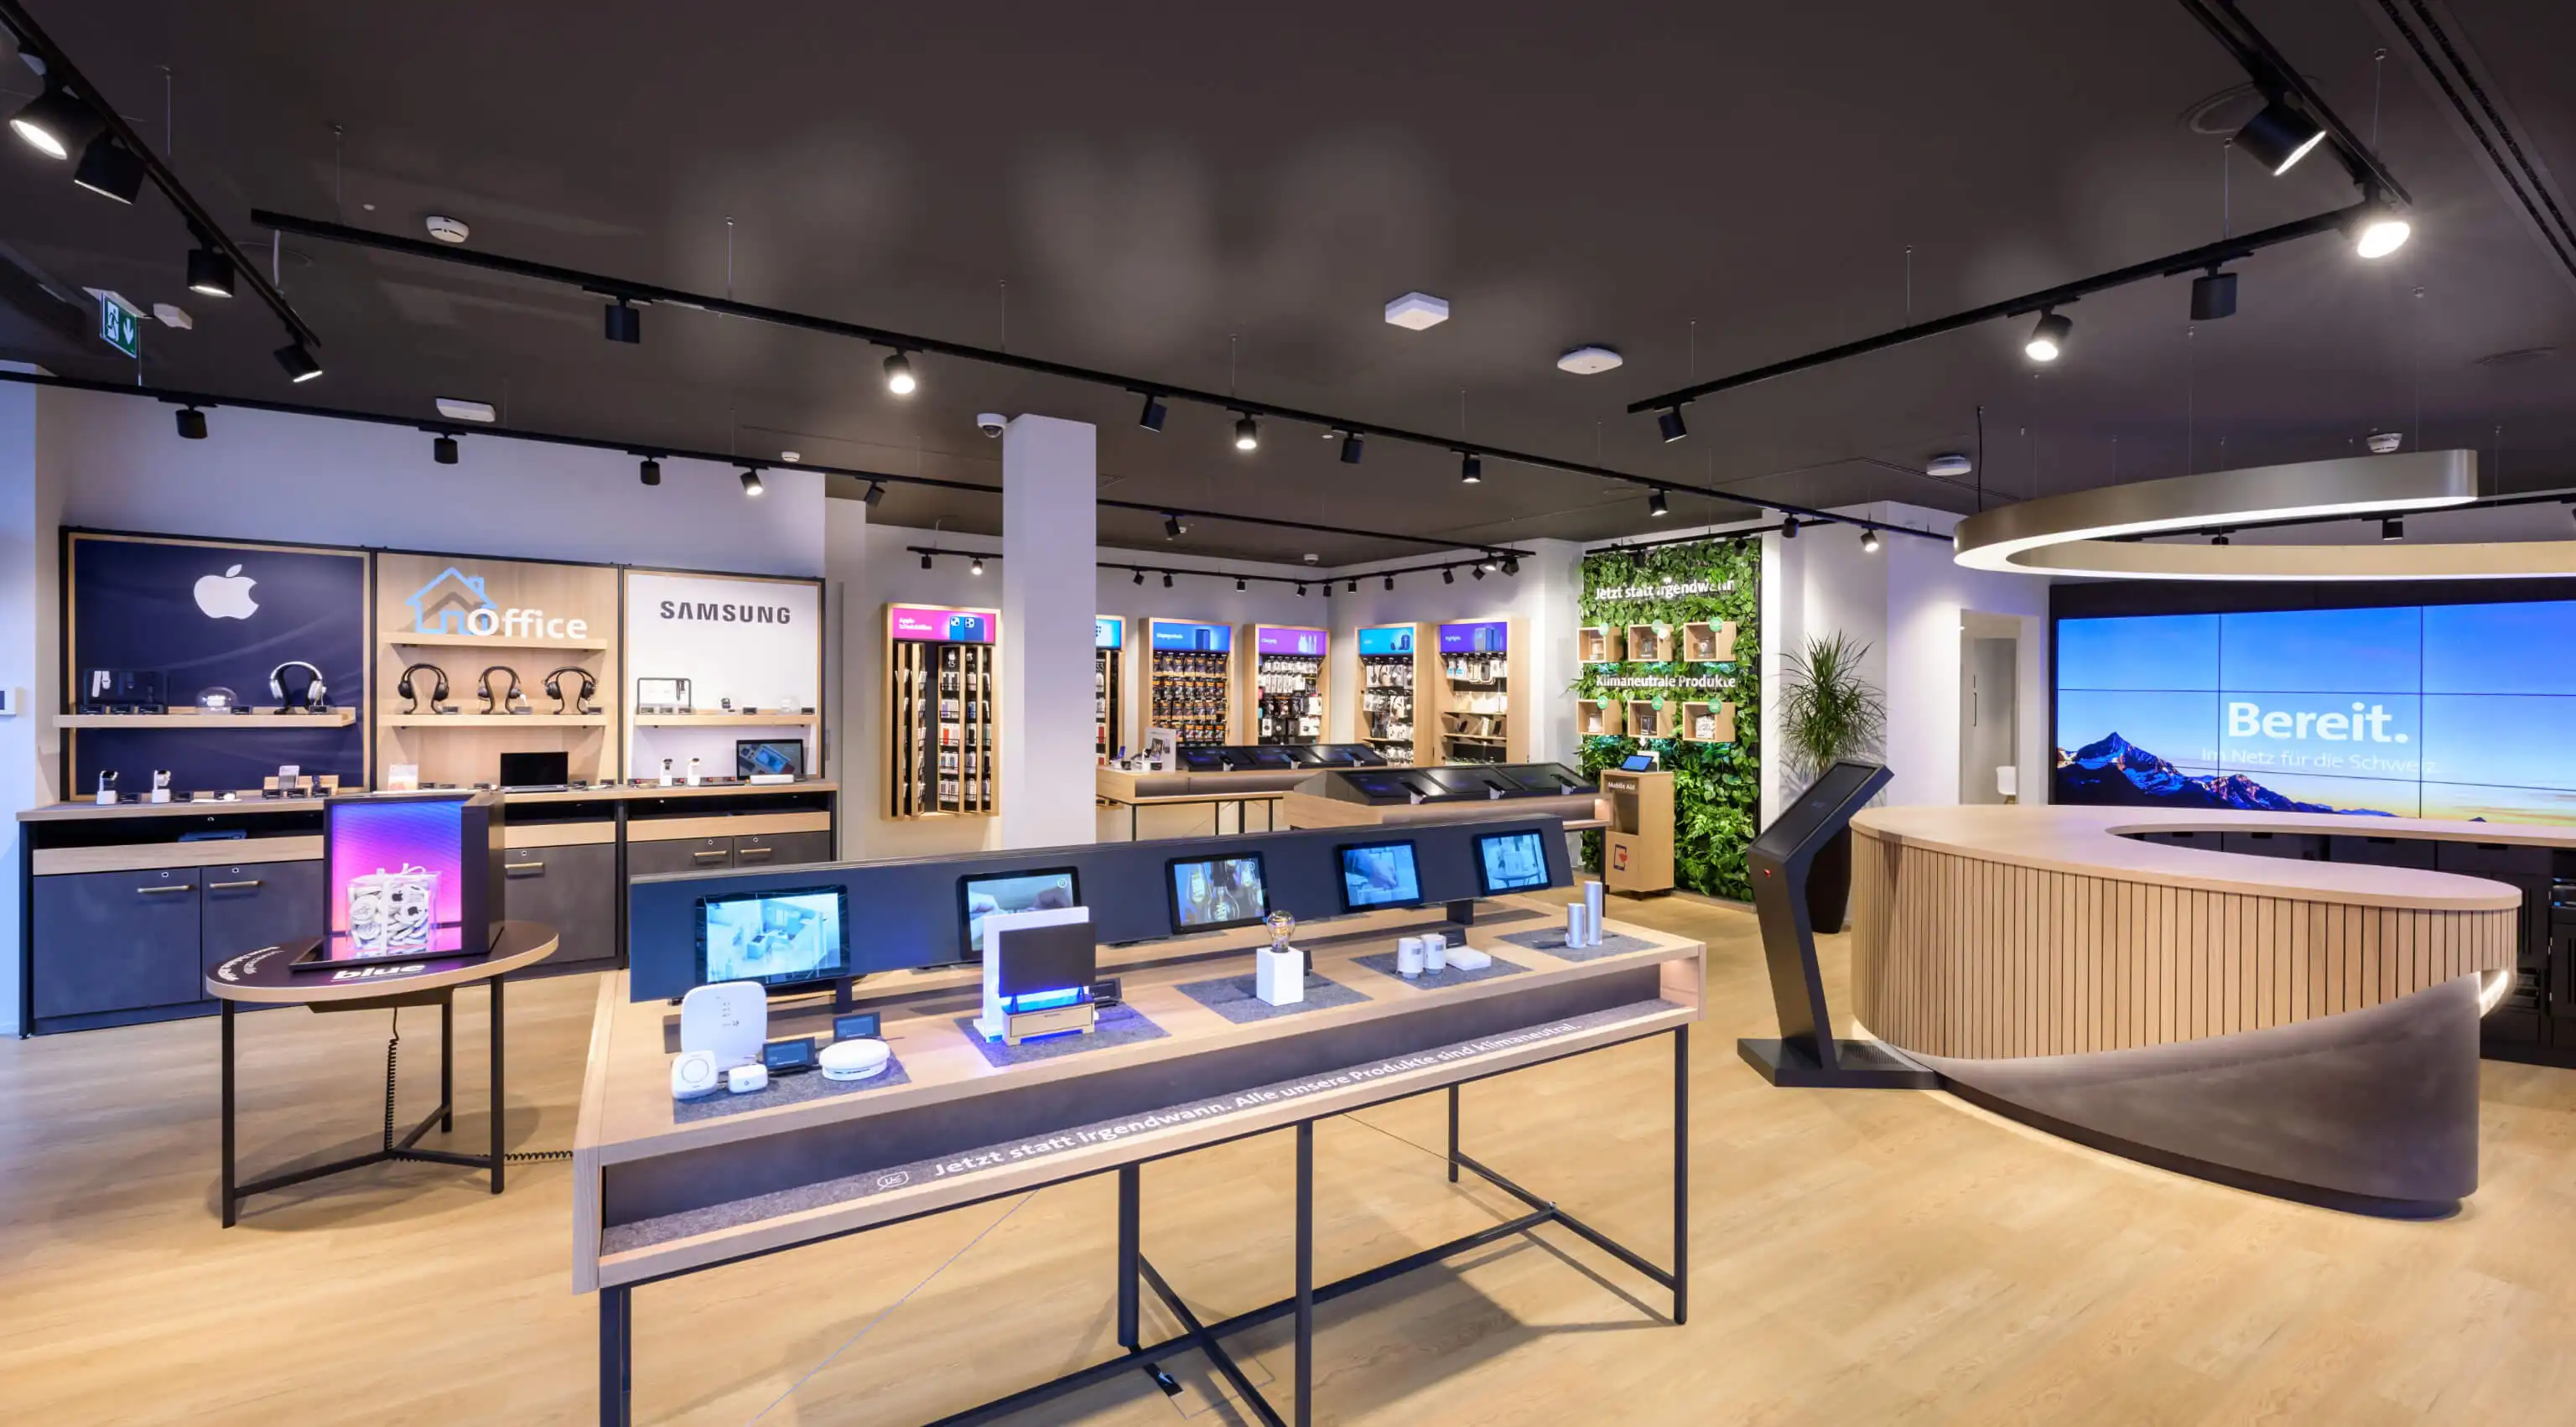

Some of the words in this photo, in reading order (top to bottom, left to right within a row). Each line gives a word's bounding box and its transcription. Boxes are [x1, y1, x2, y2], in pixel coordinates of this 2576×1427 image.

[1595, 586, 1623, 600] Jetzt
[1625, 585, 1654, 598] statt
[467, 608, 588, 640] Office
[660, 600, 791, 625] SAMSUNG
[1596, 674, 1676, 687] Klimaneutrale
[1679, 674, 1736, 688] Produkte
[2228, 702, 2409, 744] Bereit.
[2201, 747, 2226, 762] Im
[2231, 749, 2276, 765] Netz
[2281, 750, 2308, 767] für
[2314, 751, 2345, 769] die
[332, 965, 426, 980] blue
[936, 1151, 1005, 1176] Jetzt
[1010, 1136, 1077, 1159] statt
[1078, 1103, 1233, 1141] irgendwann.
[1235, 1092, 1280, 1108] Alle
[1280, 1074, 1352, 1097] unsere
[1353, 1054, 1437, 1082] Produkte
[1438, 1046, 1476, 1061] sind
[1478, 1023, 1582, 1051] klimaneutral.
